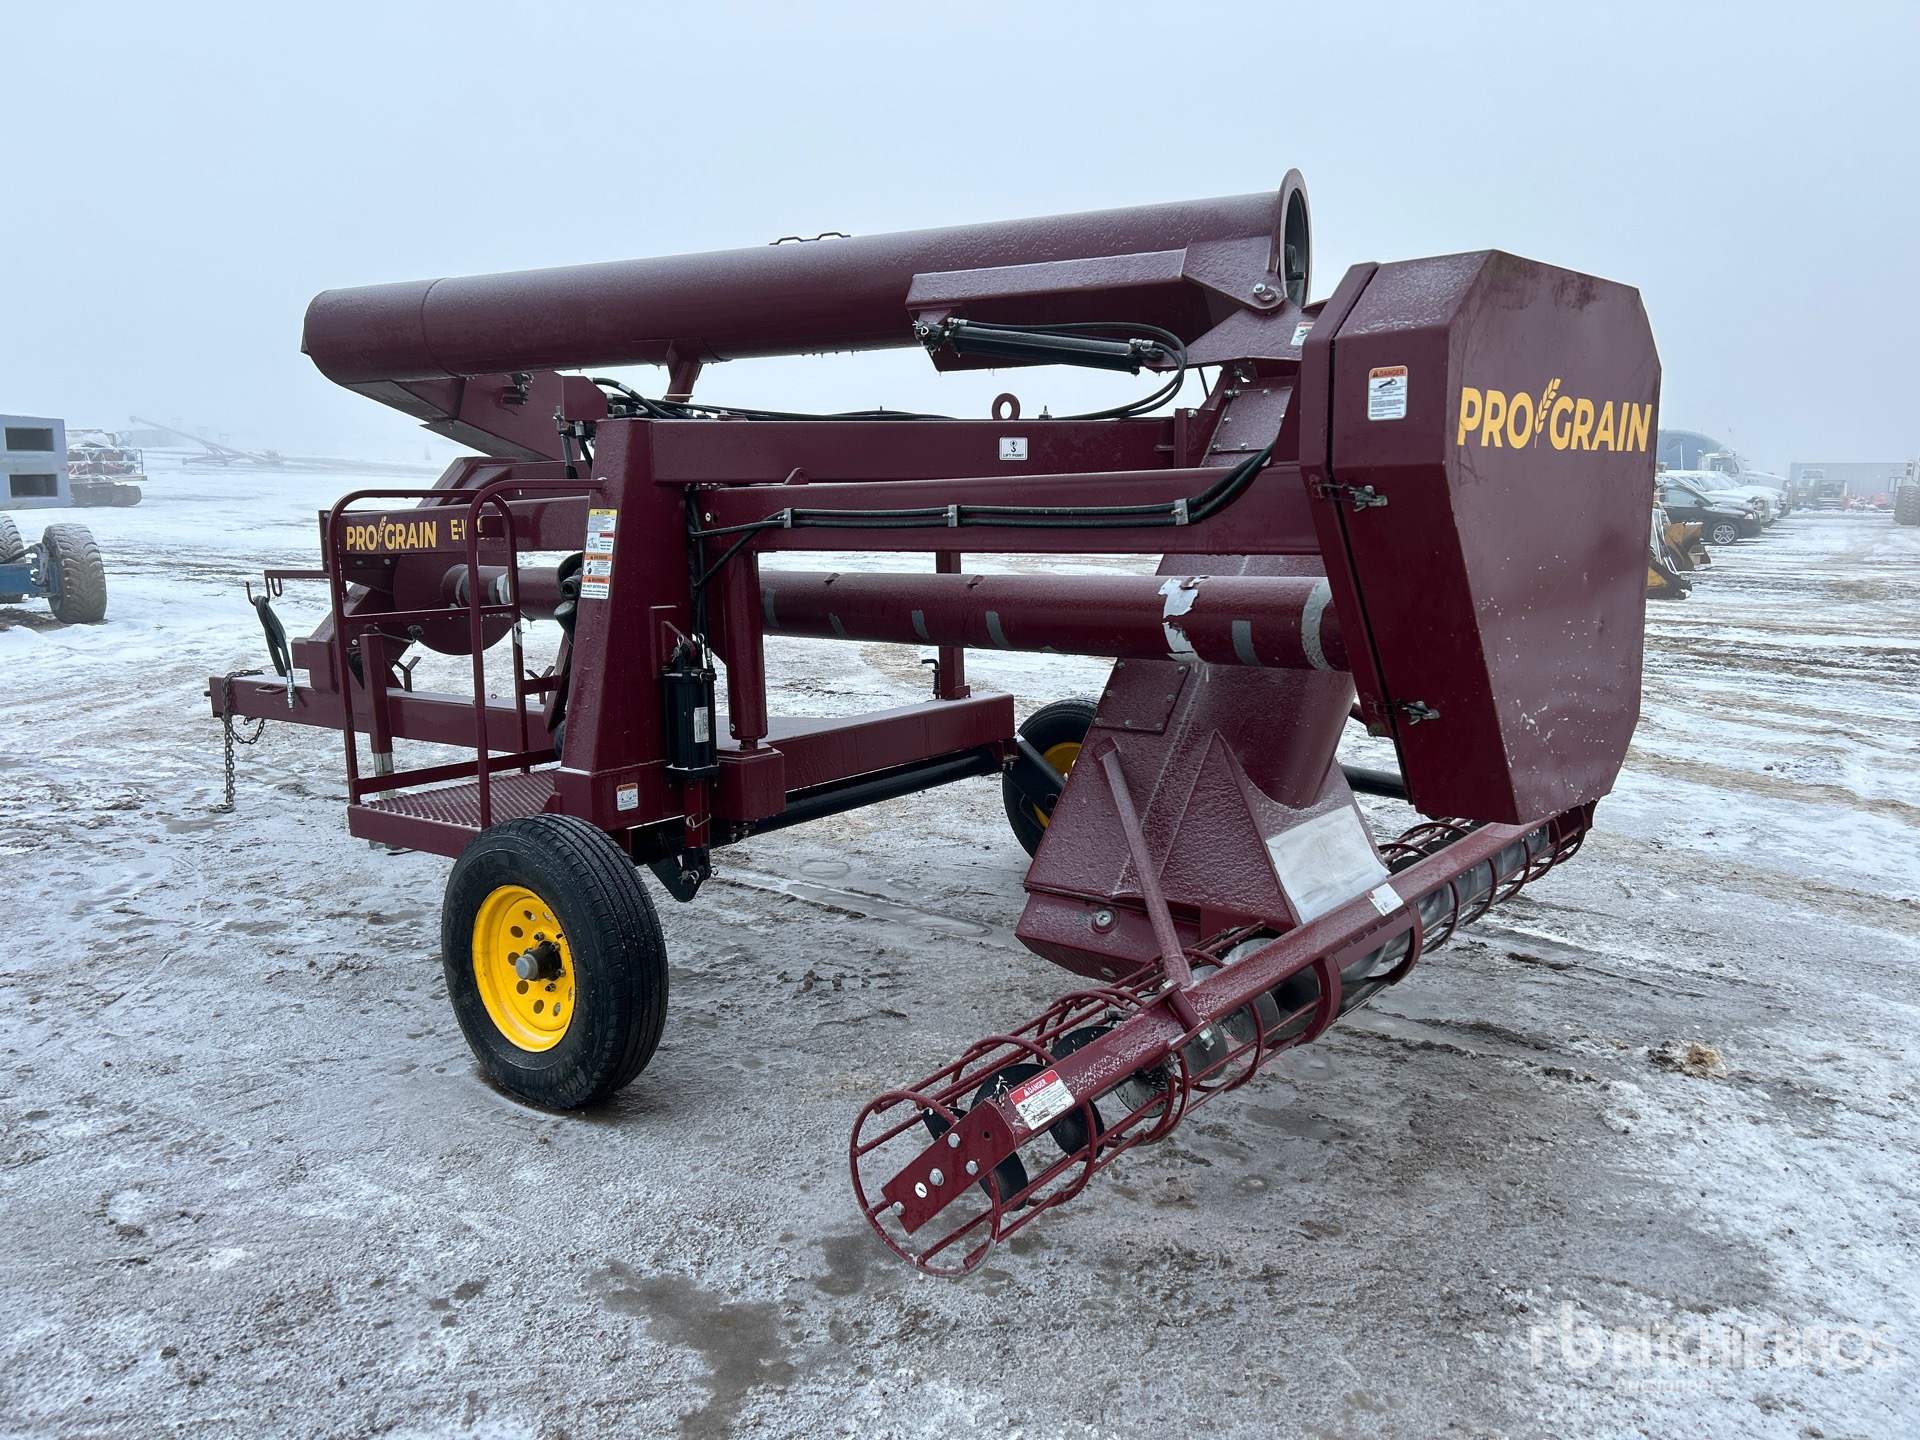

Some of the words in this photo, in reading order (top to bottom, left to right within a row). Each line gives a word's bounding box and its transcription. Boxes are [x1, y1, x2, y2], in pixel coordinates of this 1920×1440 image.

[1457, 386, 1534, 449] PRO
[1550, 396, 1653, 452] GRAIN
[346, 525, 377, 551] PRO
[384, 520, 437, 550] GRAIN
[1028, 1078, 1048, 1094] DANGER
